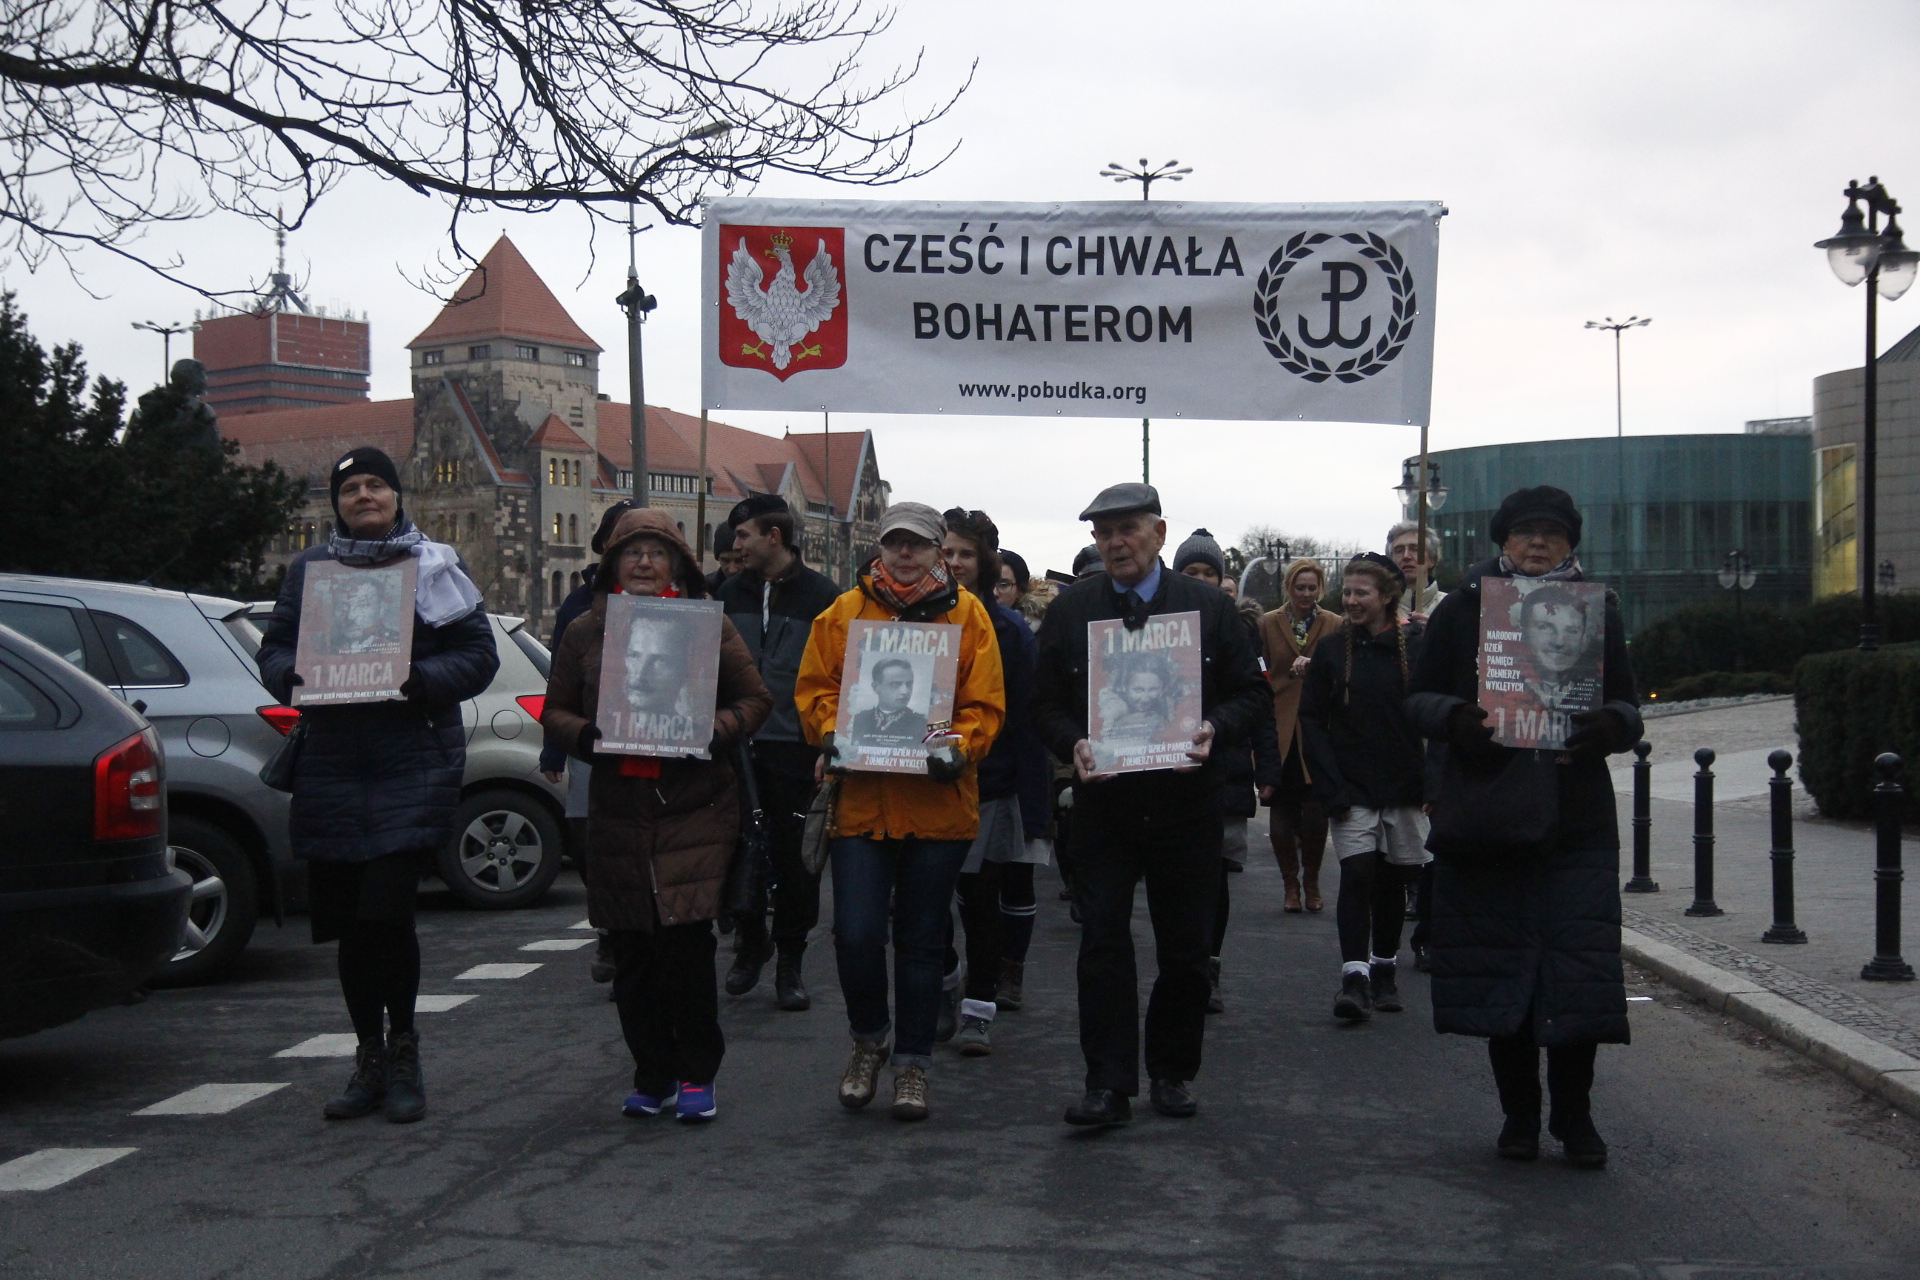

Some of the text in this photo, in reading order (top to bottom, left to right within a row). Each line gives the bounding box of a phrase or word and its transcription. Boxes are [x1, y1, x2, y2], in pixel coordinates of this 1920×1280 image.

[864, 223, 1244, 277] CZEŚĆ I CHWAŁA
[913, 301, 1193, 343] BOHATEROM
[958, 380, 1147, 403] www.pobudka.org
[863, 627, 949, 657] 1 MARCA
[1104, 620, 1192, 654] 1 MARCA
[1484, 642, 1503, 653] DZIEŃ
[1486, 630, 1522, 642] NARODOWY
[1486, 655, 1514, 667] PAMIĘCI
[1486, 666, 1520, 680] ŻOŁNIERZY
[312, 661, 393, 688] 1 MARCA
[1486, 680, 1524, 692] WYKLĘTYCH
[612, 711, 694, 741] 1 MARCA
[1494, 708, 1506, 738] 1
[1168, 740, 1192, 752] PAMIĘCI
